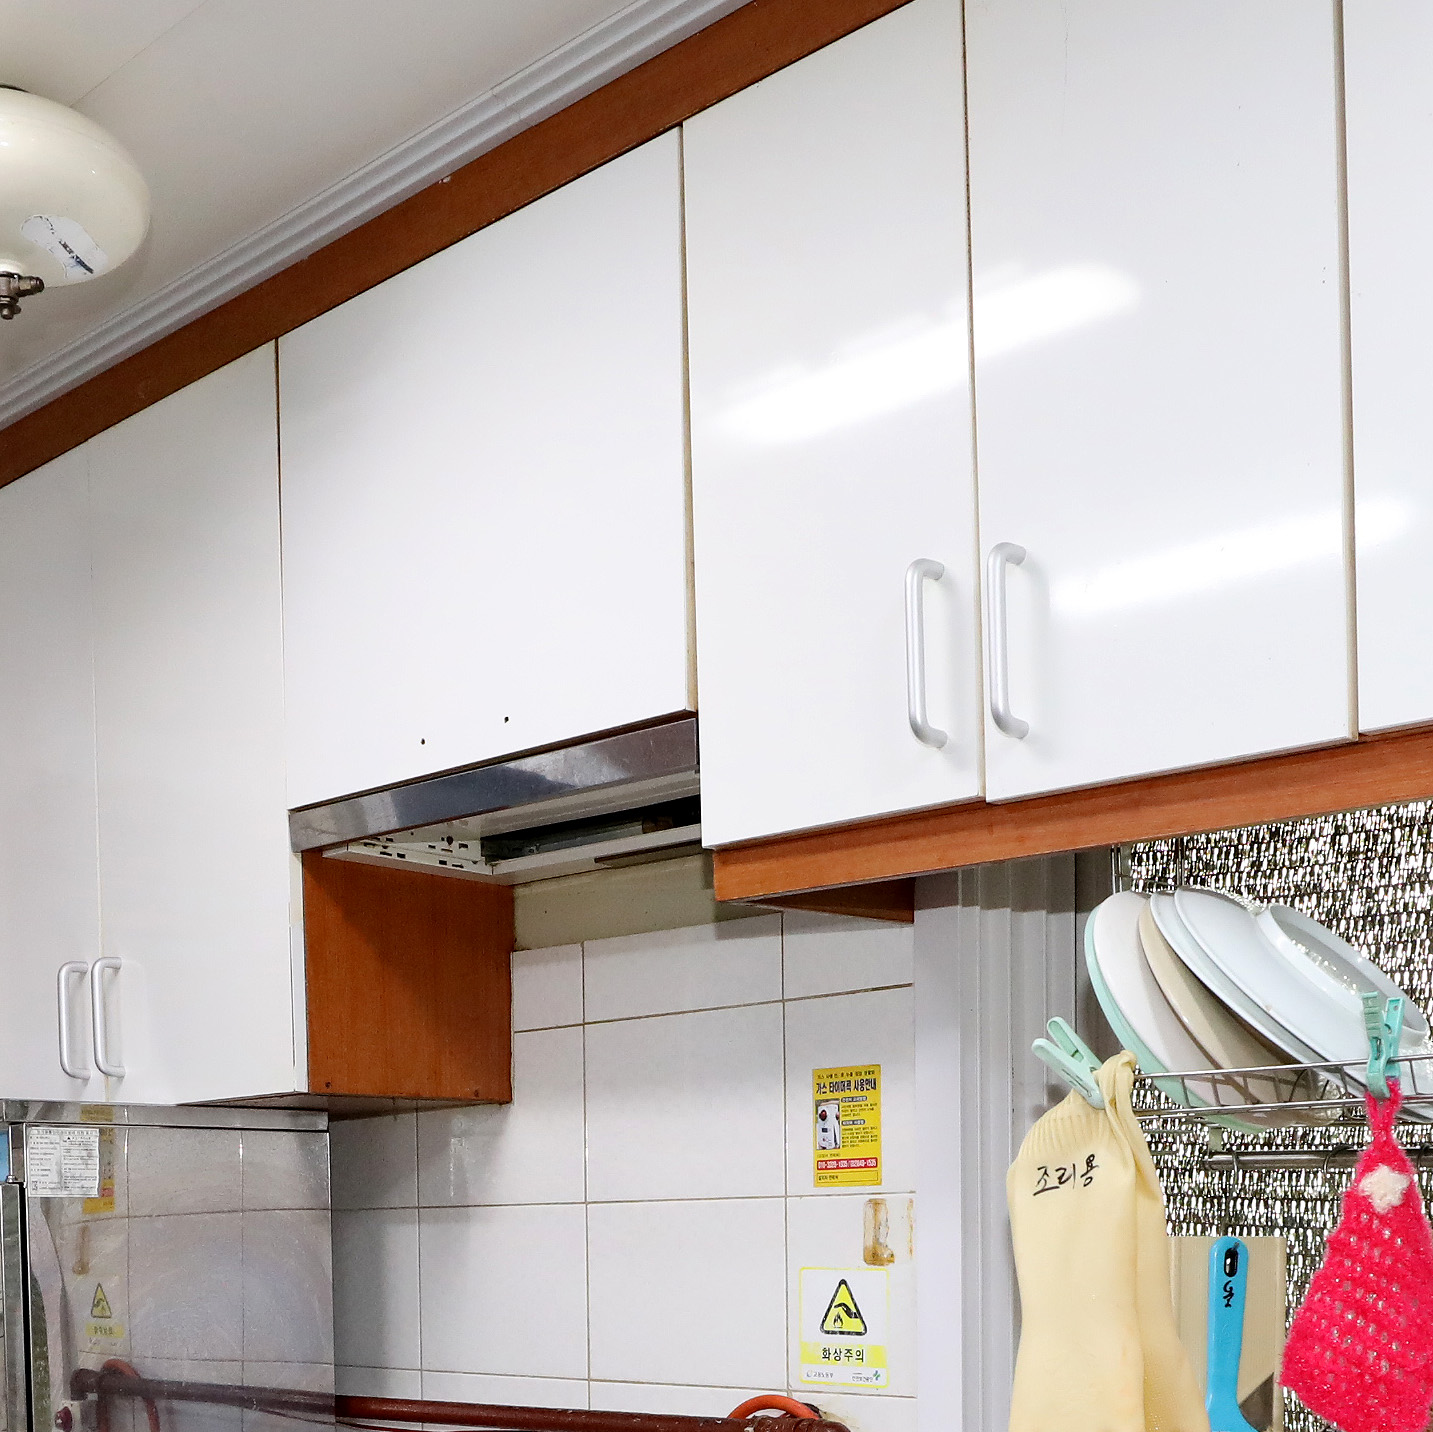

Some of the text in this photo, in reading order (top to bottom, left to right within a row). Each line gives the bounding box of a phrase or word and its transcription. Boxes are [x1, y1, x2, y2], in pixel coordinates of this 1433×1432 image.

[816, 1082, 827, 1095] 가스
[854, 1077, 877, 1091] 사용안내
[1032, 1152, 1100, 1197] 조리용
[821, 1347, 864, 1362] 화상주의
